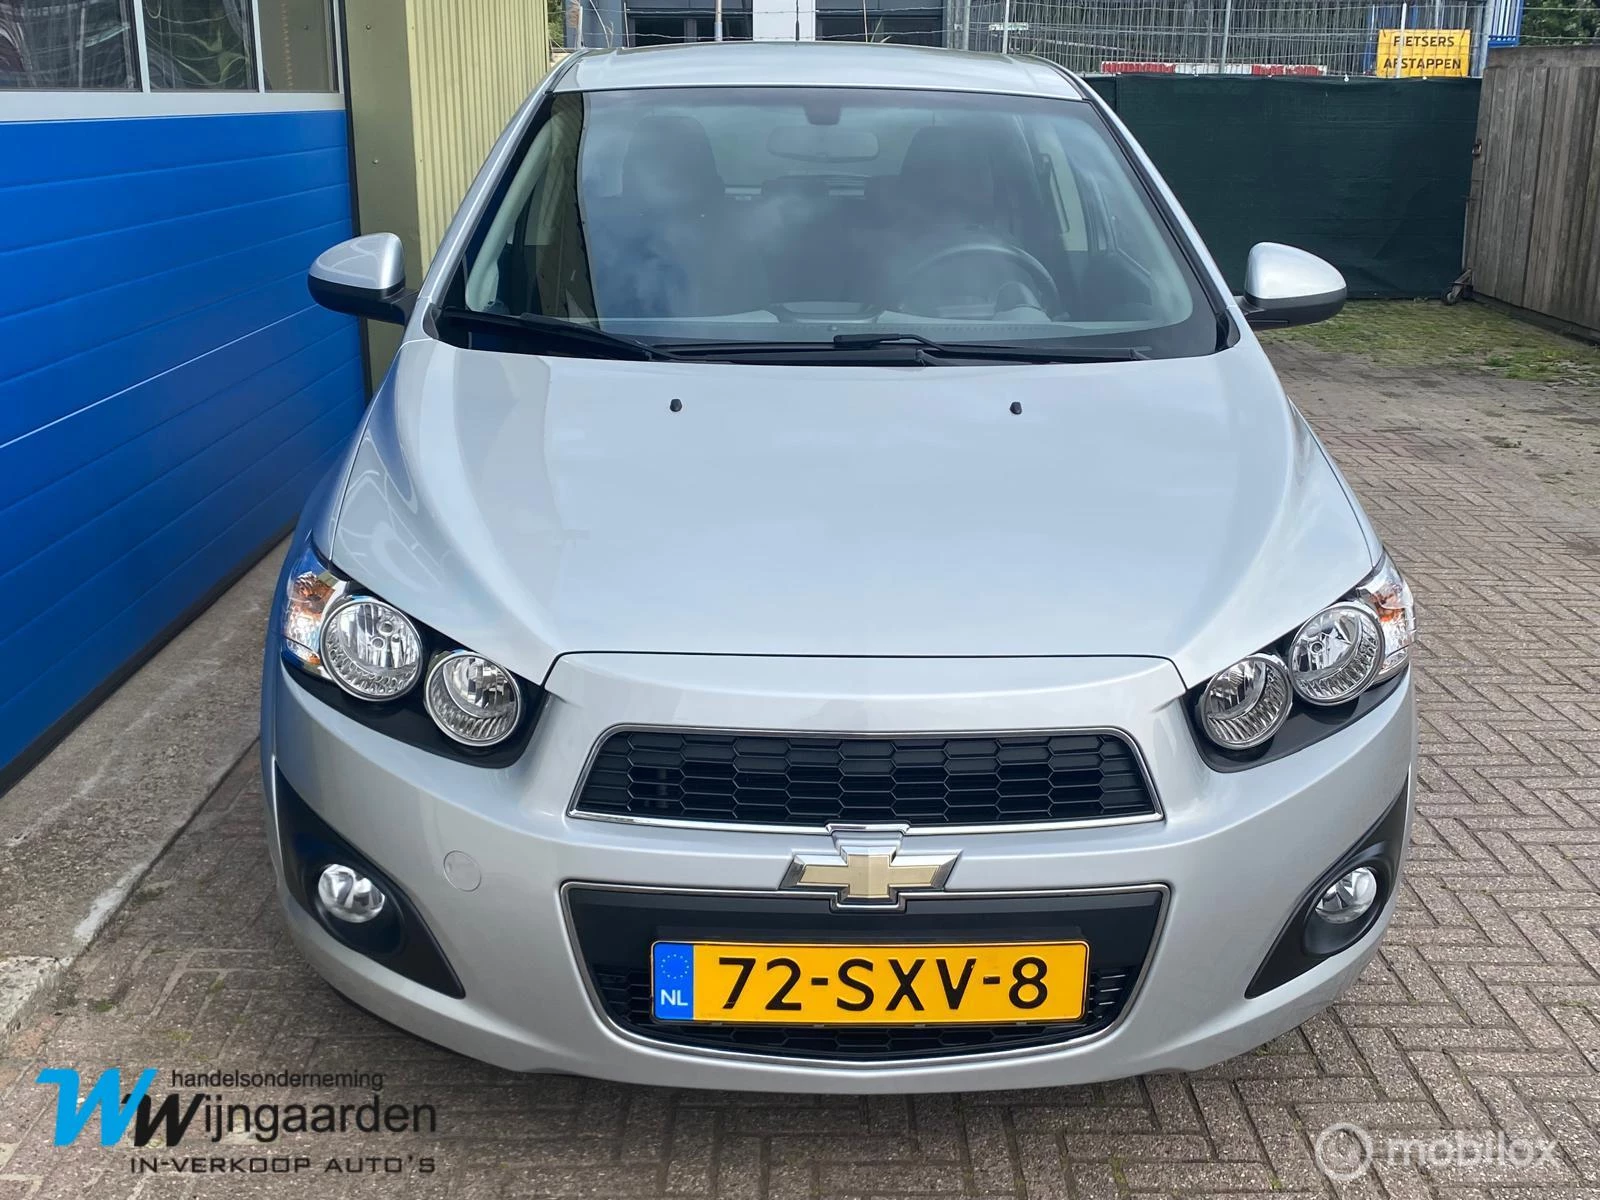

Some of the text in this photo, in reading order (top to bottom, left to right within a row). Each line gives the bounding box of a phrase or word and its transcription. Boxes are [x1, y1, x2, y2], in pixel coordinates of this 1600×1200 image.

[1383, 58, 1461, 69] AFSTAPPEN
[718, 956, 1048, 1011] 72-SXV-8
[660, 989, 688, 1006] NL
